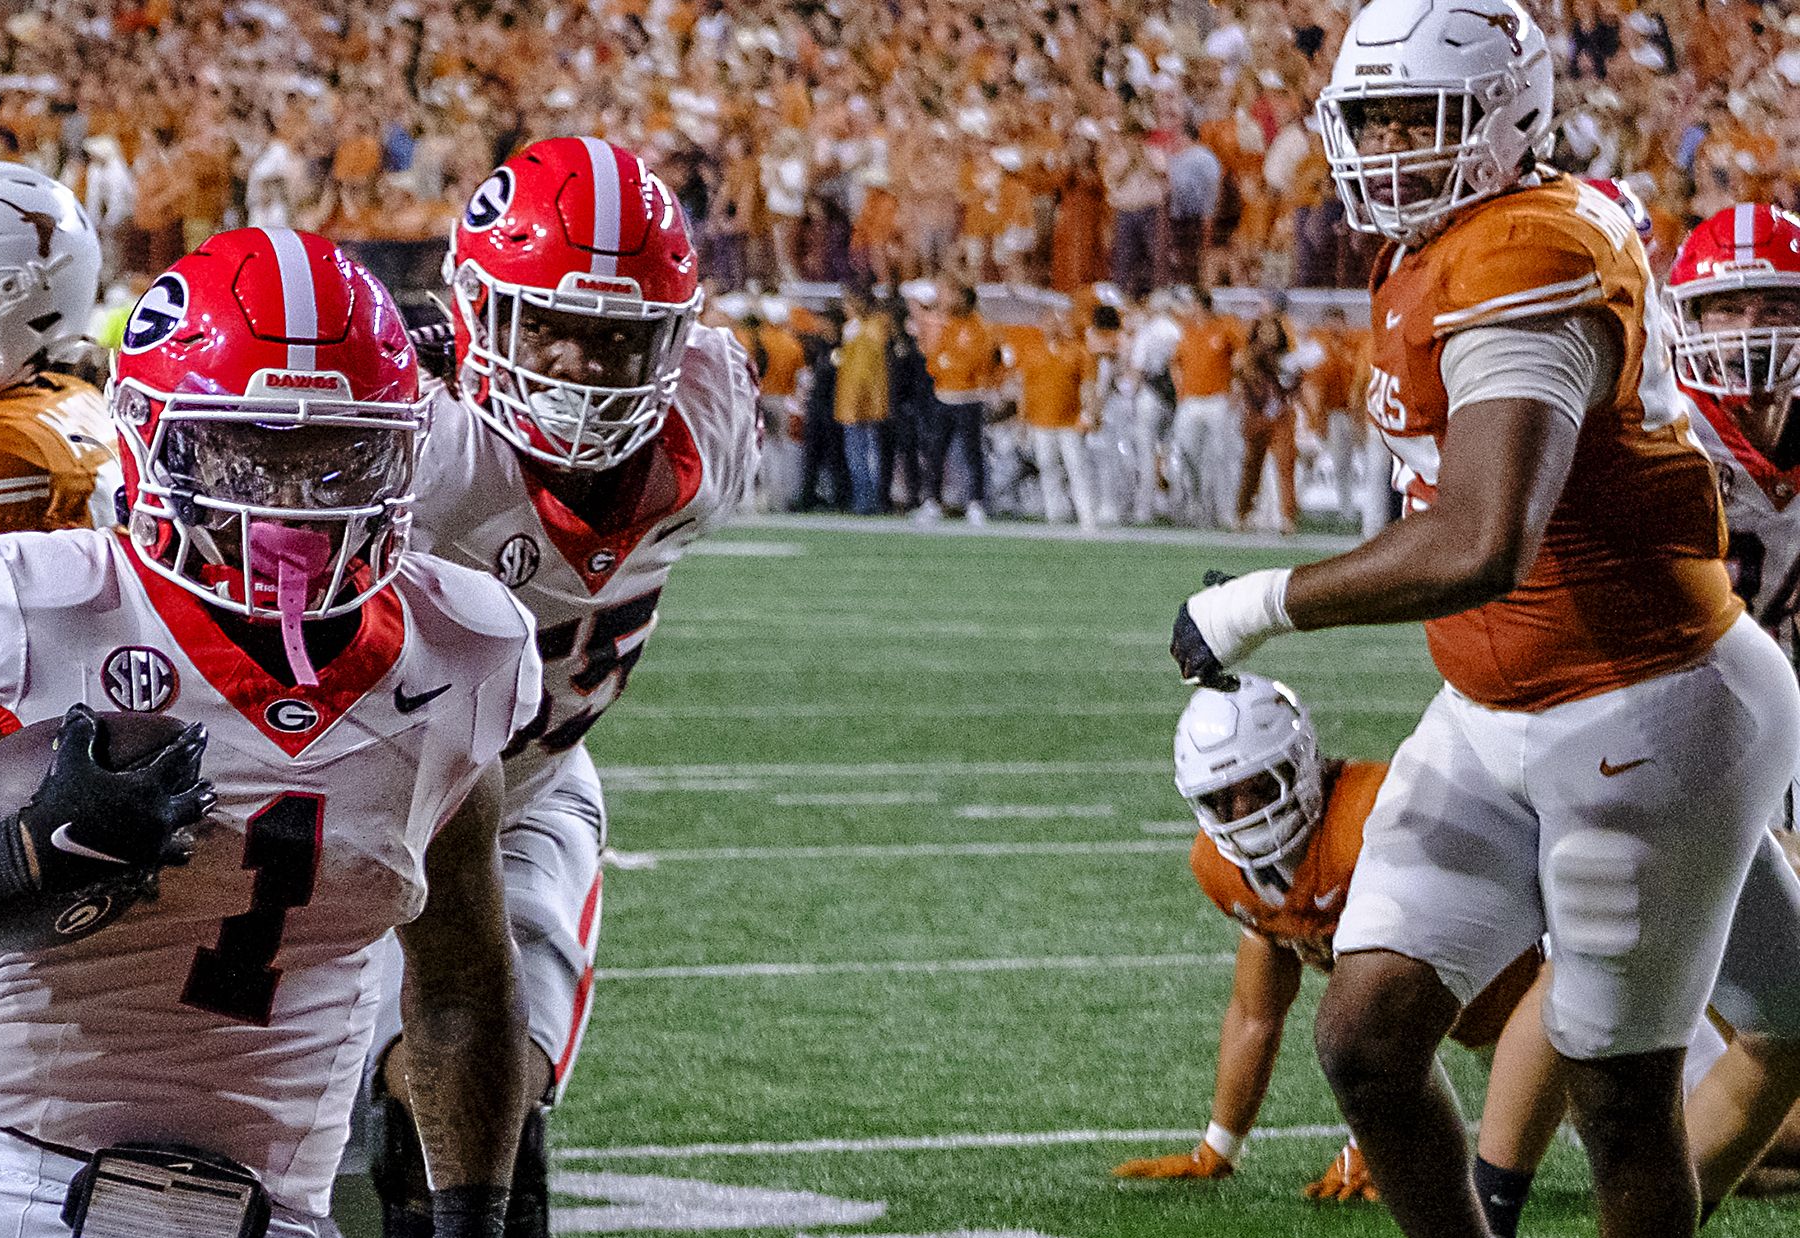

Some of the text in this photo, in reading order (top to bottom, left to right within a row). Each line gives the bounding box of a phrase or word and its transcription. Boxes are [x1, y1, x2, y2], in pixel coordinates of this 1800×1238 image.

[127, 283, 188, 337] G
[264, 372, 340, 391] DAWGS
[105, 649, 171, 713] SEC
[275, 702, 319, 728] G
[177, 789, 327, 1028] 1
